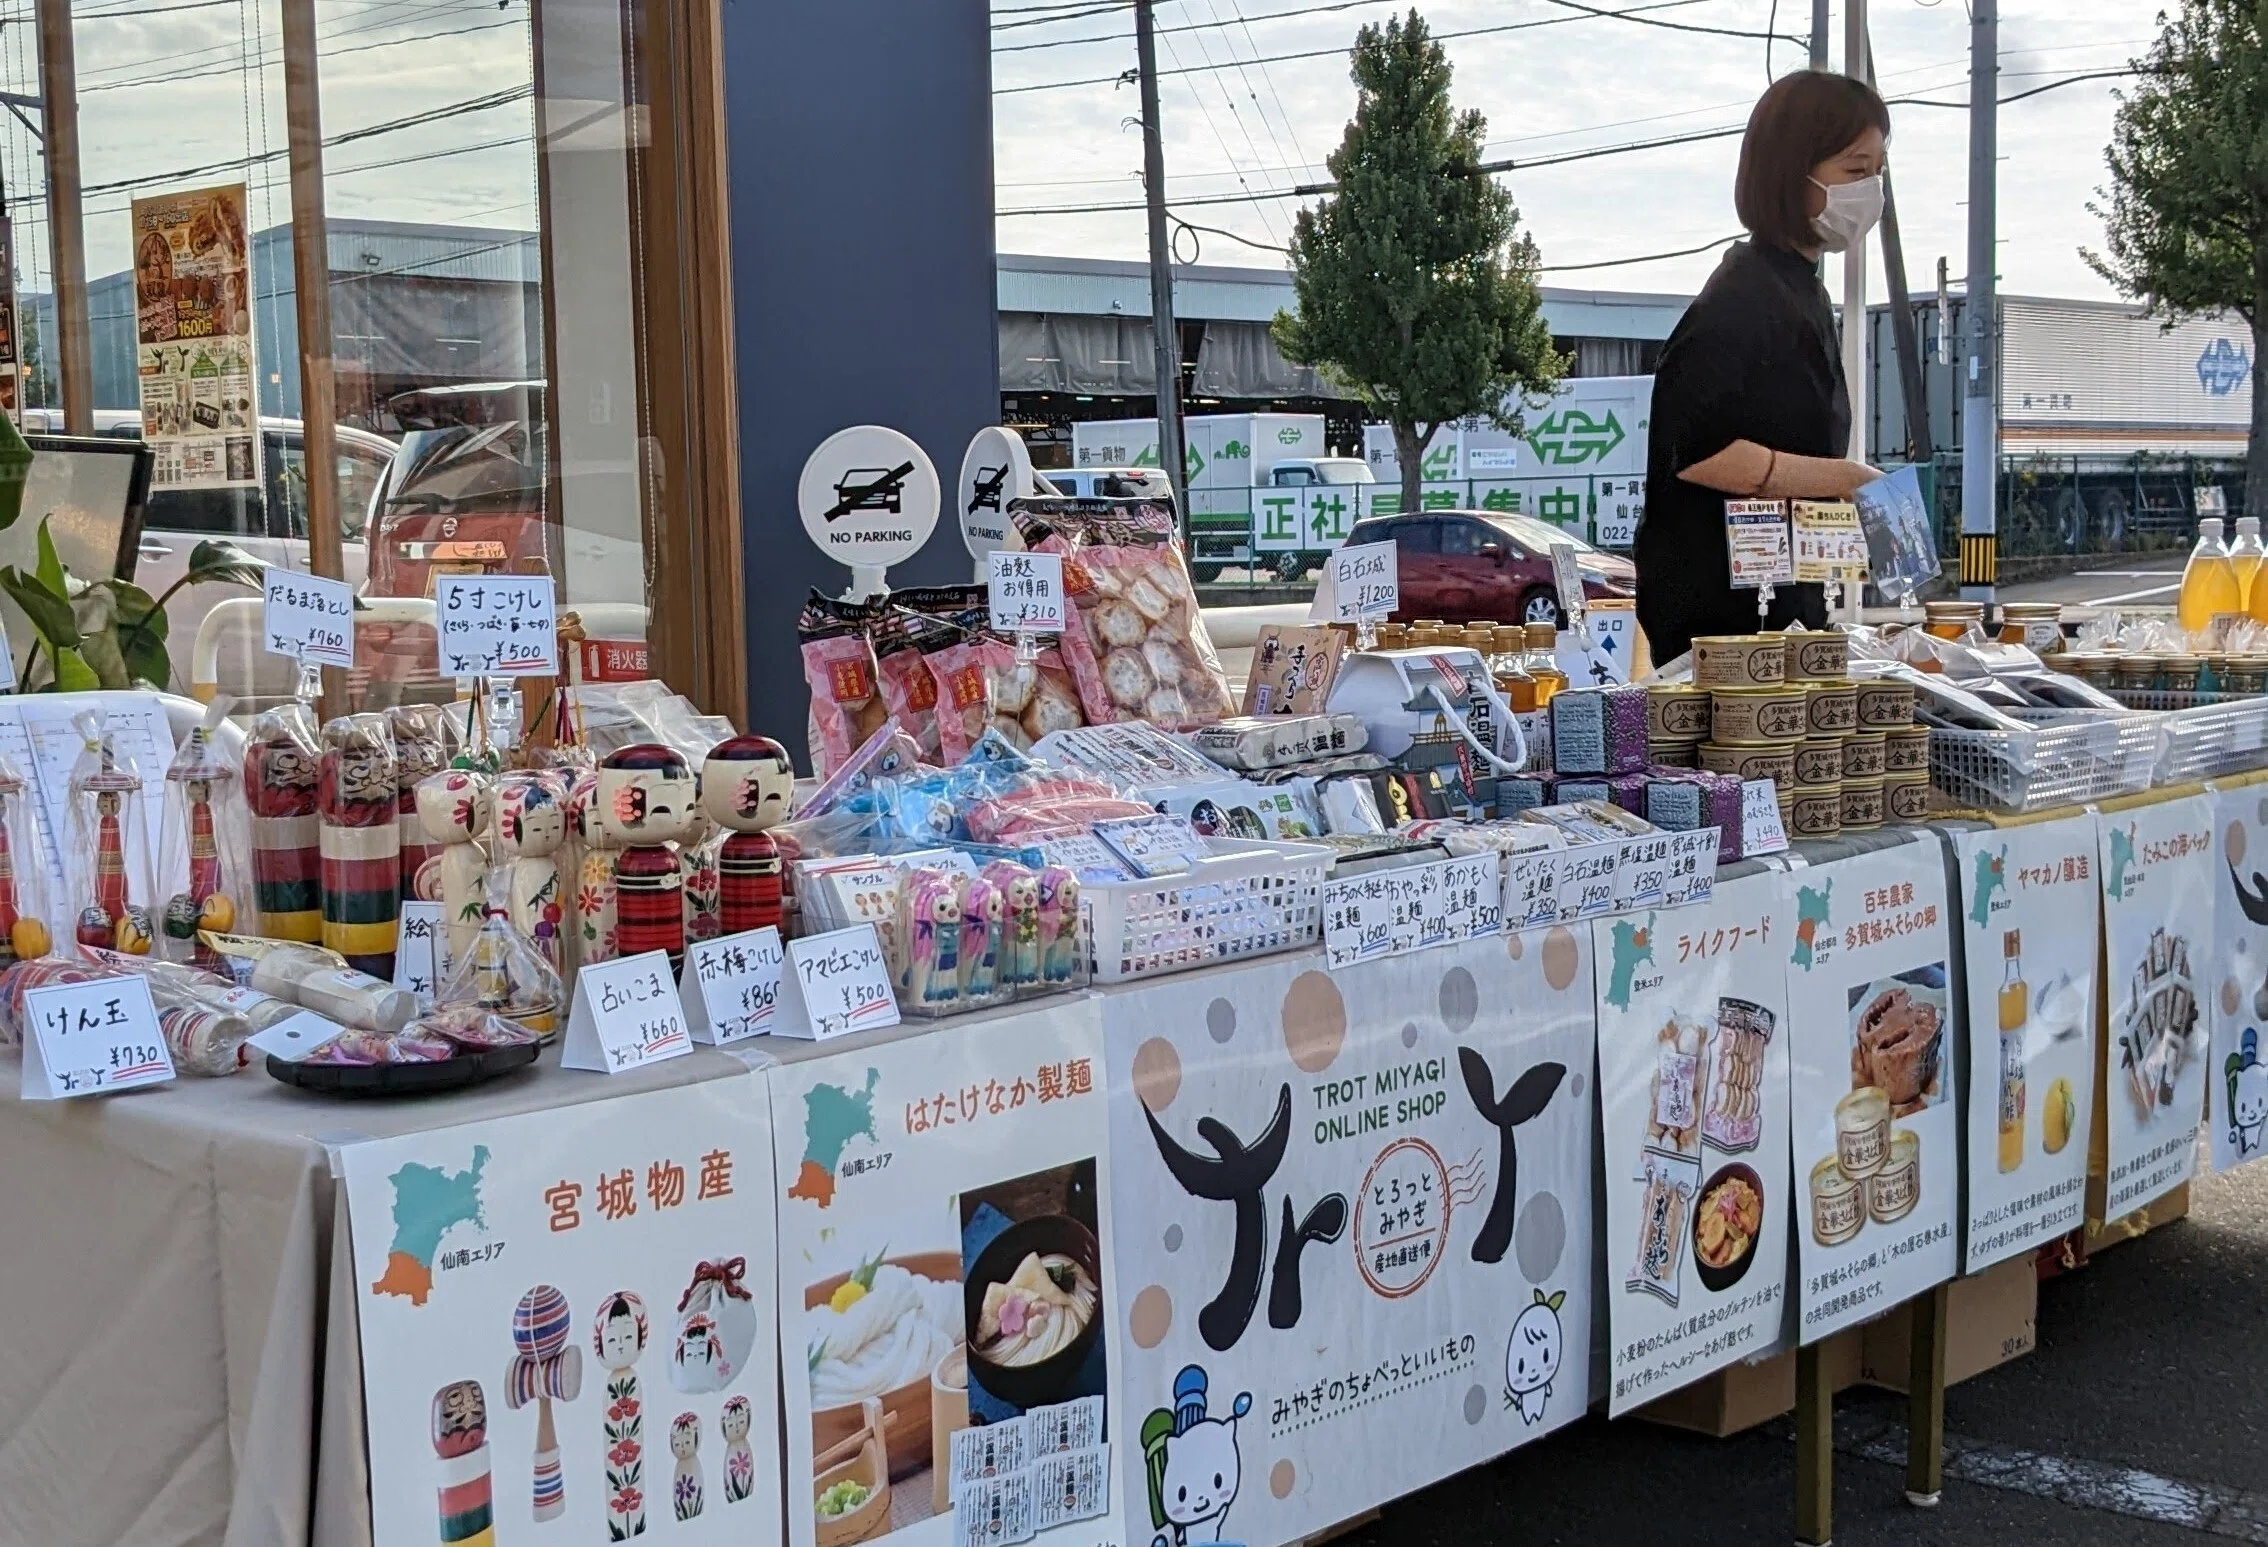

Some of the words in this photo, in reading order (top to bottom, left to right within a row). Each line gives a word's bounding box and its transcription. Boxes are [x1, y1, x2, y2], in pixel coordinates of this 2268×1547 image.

[1079, 446, 1126, 463] 第一貨物
[830, 532, 850, 544] NO
[855, 529, 912, 543] PARKING
[968, 526, 980, 538] NO
[982, 526, 1003, 541] PARKING
[1339, 554, 1387, 583] 白石城
[270, 585, 349, 615] だるま落とし
[1003, 579, 1049, 598] お得用
[1021, 603, 1056, 620] ¥310
[308, 628, 343, 647] ¥760
[1598, 619, 1623, 632] 出口
[495, 641, 541, 664] ¥500
[607, 648, 649, 671] 消火器
[1756, 826, 1780, 840] ¥490
[1444, 863, 1488, 887] あかもく
[1514, 857, 1556, 881] ぜいたく
[1562, 855, 1615, 884] 白石温麺
[1633, 870, 1663, 892] ¥350
[2018, 854, 2090, 890] ヤマカノ醸造
[1581, 885, 1610, 906] ¥400
[1686, 875, 1713, 896] ¥400
[1864, 881, 1915, 914] 百年農家
[1471, 905, 1499, 931] ¥500
[1527, 898, 1558, 919] ¥350
[1358, 923, 1388, 947] ¥600
[1420, 916, 1446, 942] ¥400
[1678, 915, 1771, 964] ライクフード
[1845, 905, 1937, 951] 多賀城みそらの郷
[799, 947, 880, 984] アマビエこけし
[601, 973, 666, 1013] 占いこま
[842, 983, 885, 1009] ¥500
[1634, 975, 1664, 992] 登米エリア
[46, 997, 129, 1036] けん玉
[639, 1015, 679, 1042] ¥660
[110, 1044, 158, 1067] ¥730
[1313, 1074, 1367, 1110] TROT
[1374, 1057, 1447, 1097] MIYAGI
[905, 1057, 1095, 1137] はたけなか製麺
[1314, 1107, 1389, 1146] ONLINE
[1396, 1091, 1447, 1125] SHOP
[841, 1151, 893, 1180] 仙南エリア
[543, 1147, 734, 1234] 宮城物産
[1374, 1172, 1433, 1206] とろっと
[1380, 1201, 1427, 1235] みやぎ
[439, 1241, 506, 1273] 仙南エリア
[1374, 1238, 1432, 1274] 産地直送便
[1805, 1280, 1884, 1325] の共同開発商品です。
[1271, 1334, 1476, 1424] みやぎのちょべっといいもの
